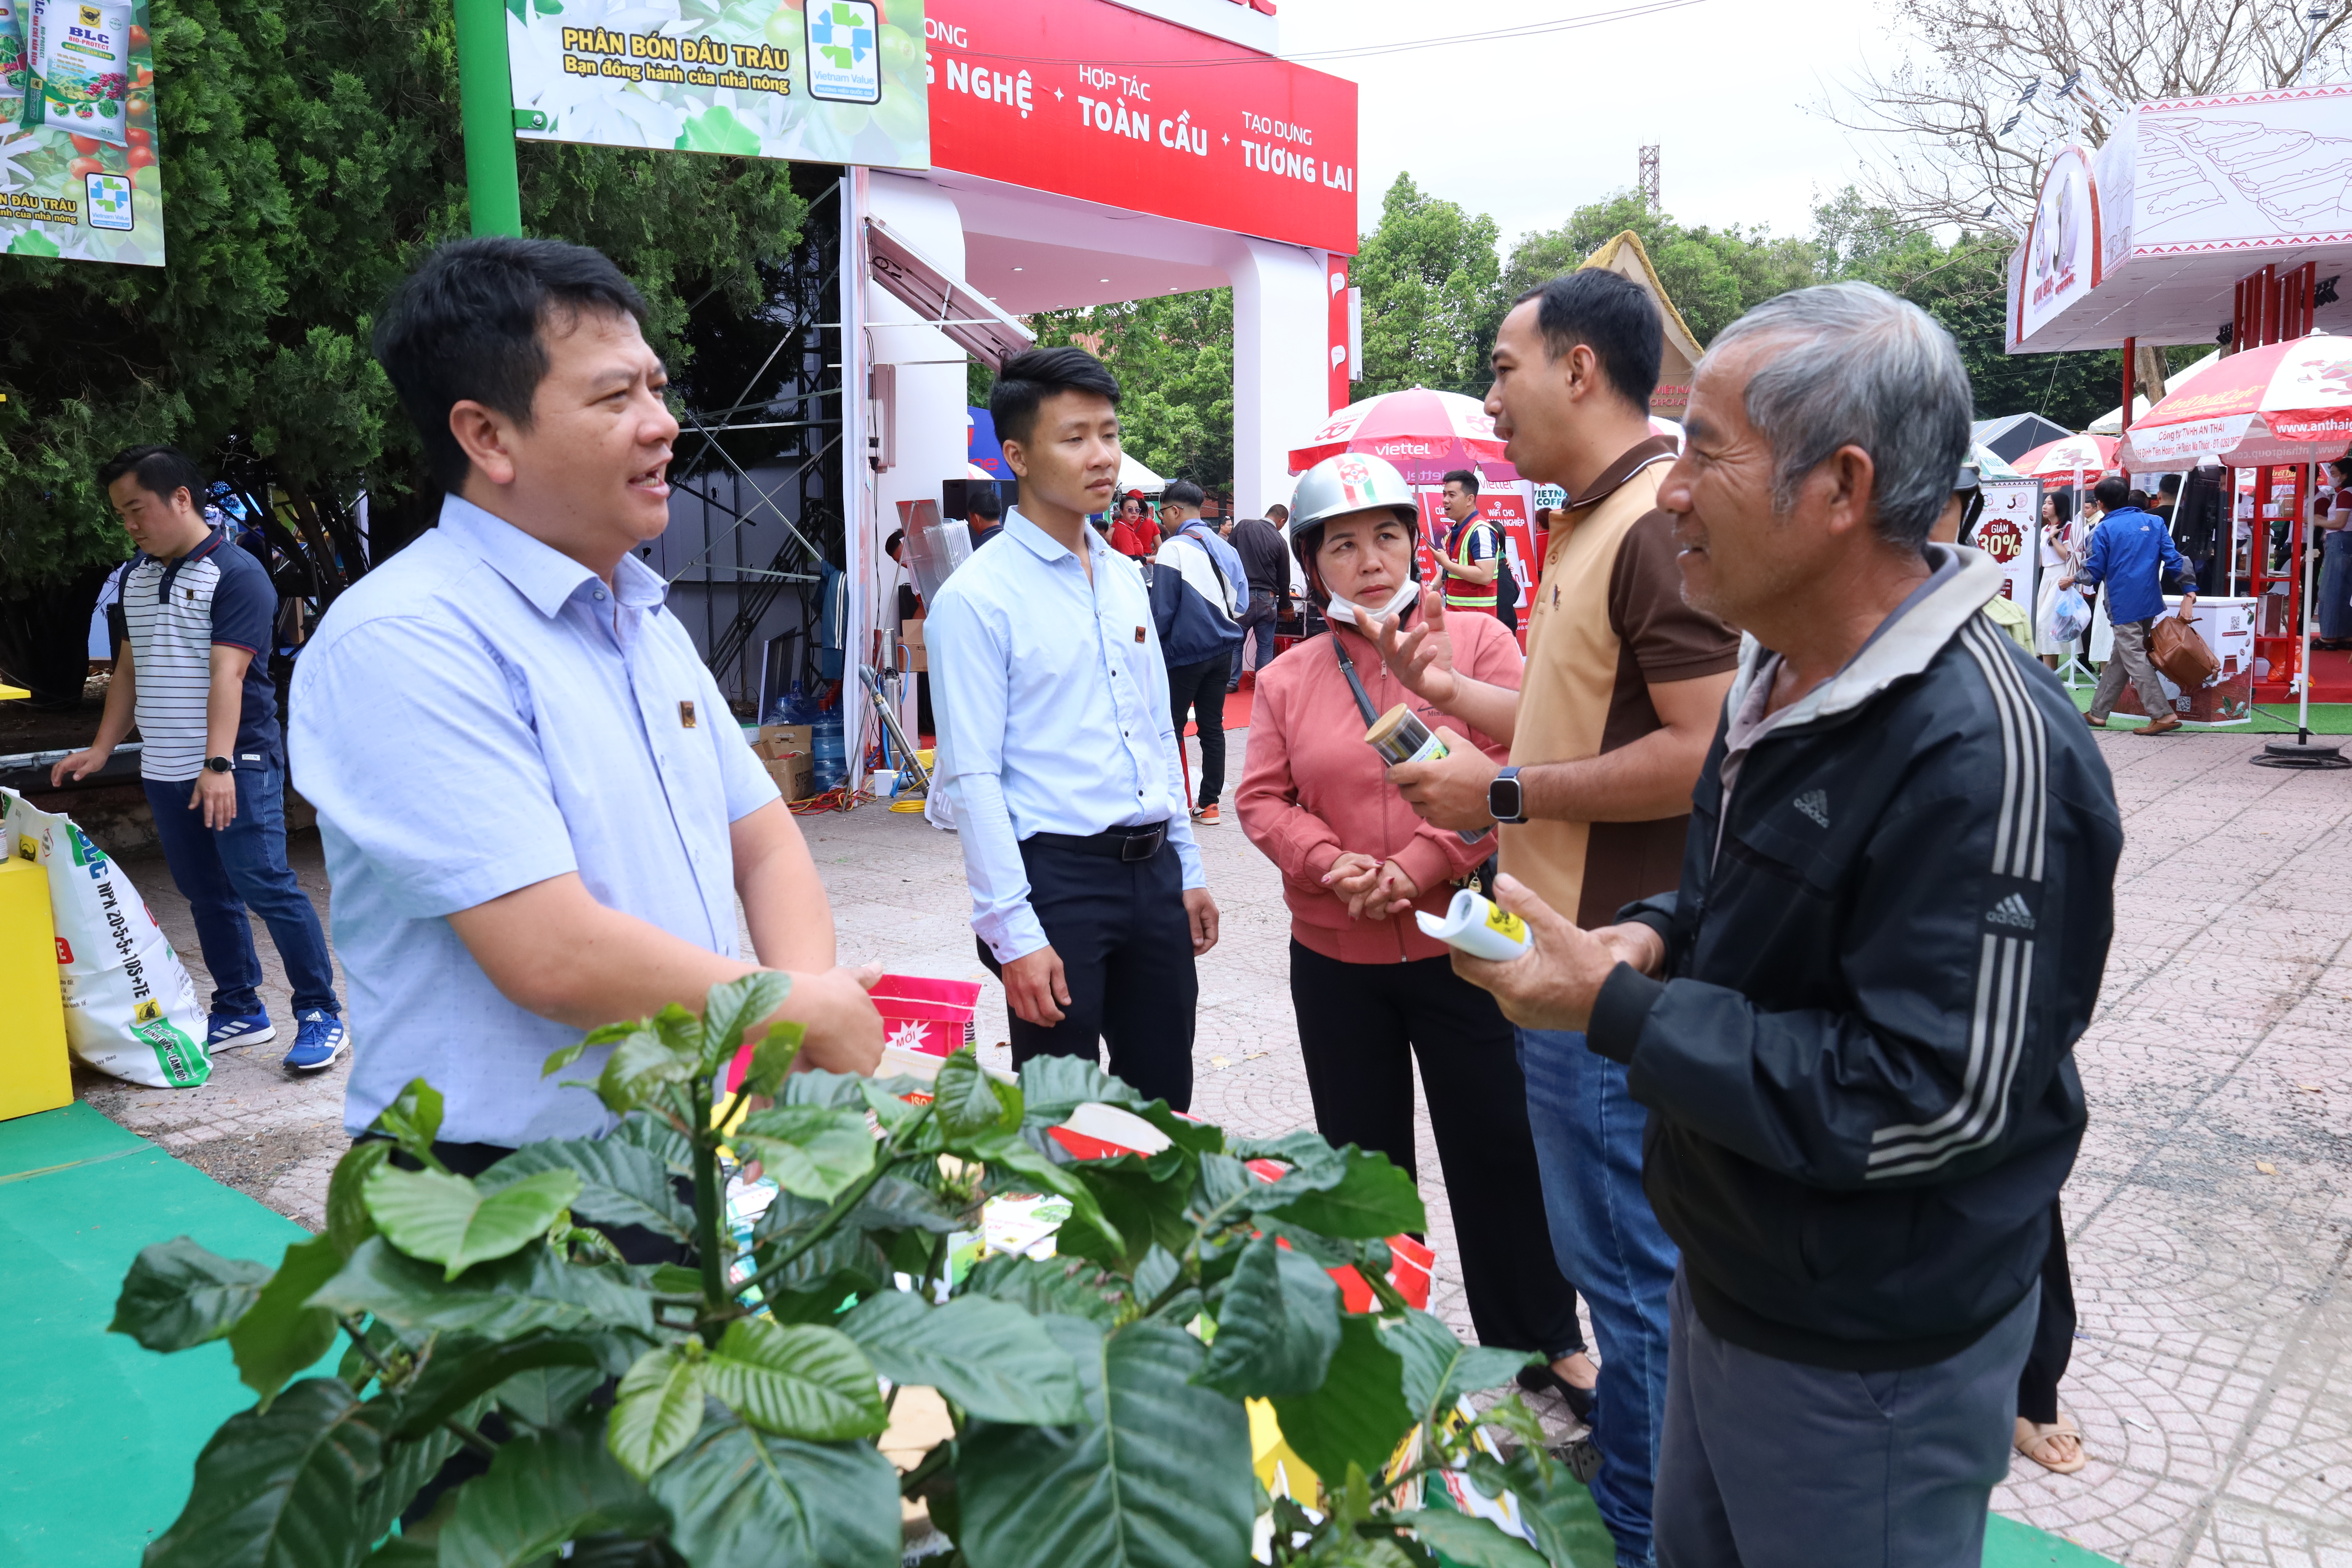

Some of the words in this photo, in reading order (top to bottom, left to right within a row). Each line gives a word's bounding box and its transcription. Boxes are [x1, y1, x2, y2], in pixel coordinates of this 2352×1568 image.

[69, 26, 109, 44] BLC
[69, 36, 109, 50] BIO-PROTECT
[564, 29, 625, 54] PHÂN
[631, 32, 676, 60] BÓN
[682, 36, 727, 64] ĐẦU
[732, 44, 788, 70] TRÂU
[564, 56, 597, 77] Bạn
[602, 58, 642, 81] đồng
[646, 63, 684, 83] hành
[688, 67, 715, 85] của
[720, 71, 748, 89] nhà
[752, 75, 789, 95] nông
[814, 70, 849, 82] Vietnam
[851, 74, 874, 84] Value
[1080, 64, 1116, 90] HỢP
[1119, 75, 1151, 102] TÁC
[947, 58, 1033, 119] NGHỆ
[1078, 95, 1149, 142] TOÀN
[1159, 109, 1207, 156] CẦU
[1242, 111, 1271, 134] TẠO
[1275, 121, 1312, 145] DỰNG
[1241, 139, 1316, 183] TƯƠNG
[1323, 161, 1352, 193] LAI
[12, 193, 39, 207] ĐẦU
[42, 198, 76, 212] TRÂU
[15, 209, 32, 219] của
[35, 211, 52, 221] nhà
[55, 213, 77, 224] nông
[2159, 431, 2174, 442] Công
[2182, 427, 2197, 436] TNHH
[2199, 426, 2208, 435] AN
[2210, 421, 2225, 433] THÁI
[1375, 443, 1431, 455] viettel
[1344, 476, 1368, 485] HITASA
[1504, 517, 1525, 527] NGHIỆP
[1991, 522, 2009, 533] GIẢM
[1979, 534, 2021, 556] 30%
[1793, 798, 1830, 828] adidas
[1985, 911, 2036, 930] adidas
[896, 1031, 915, 1047] MỚI
